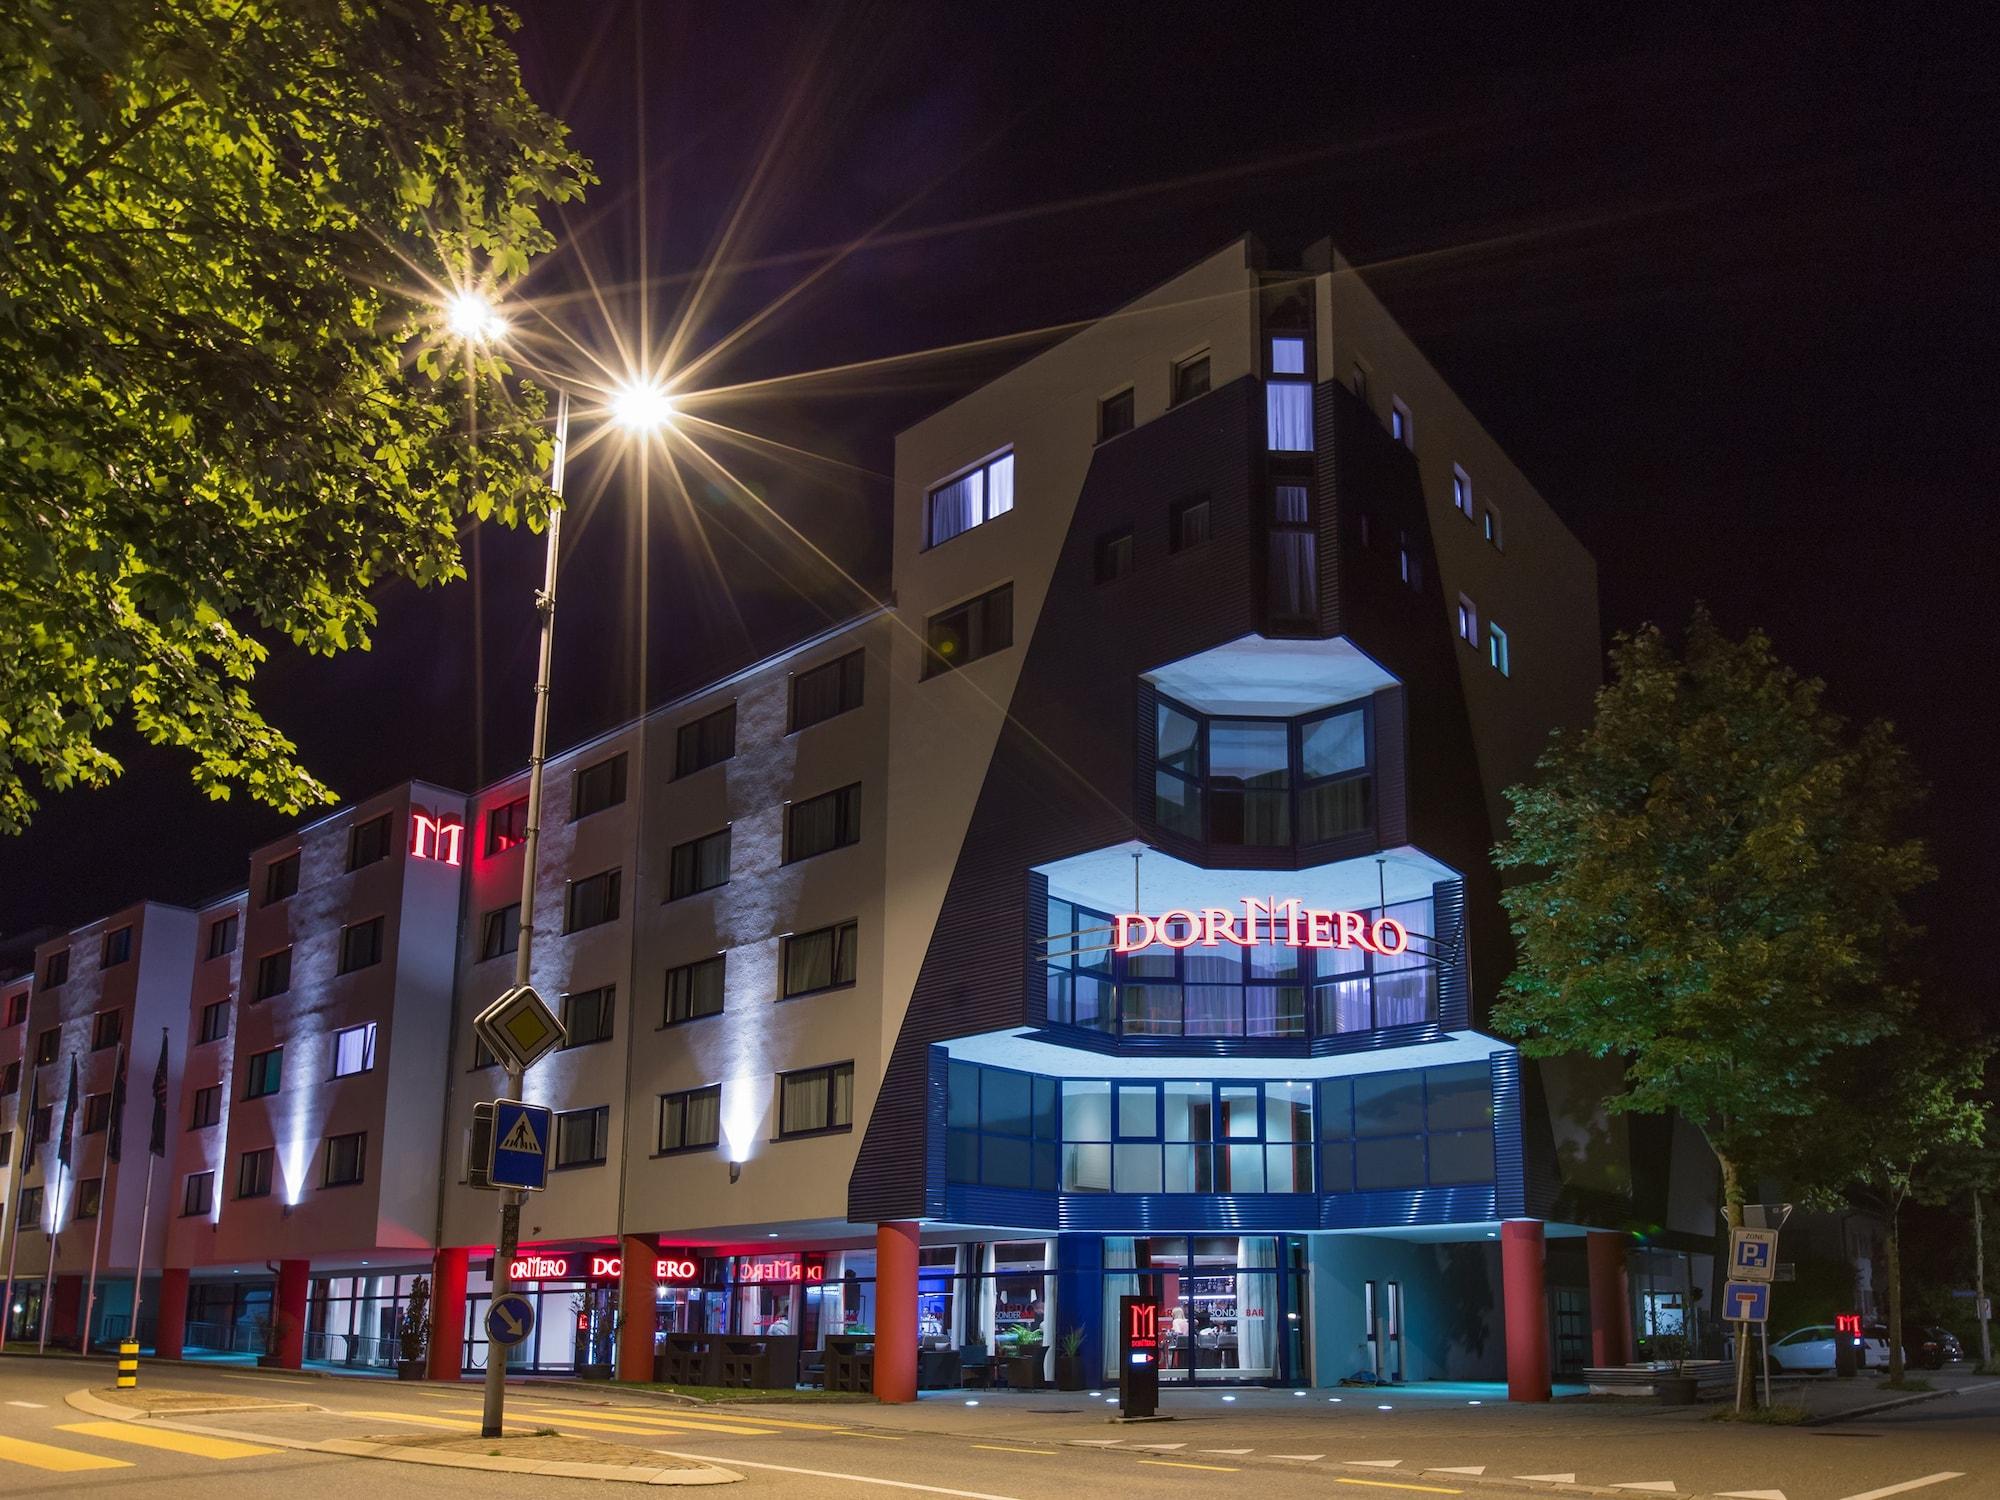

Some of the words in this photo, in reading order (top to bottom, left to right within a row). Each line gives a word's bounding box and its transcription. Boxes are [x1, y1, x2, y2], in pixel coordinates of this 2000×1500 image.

[411, 814, 464, 866] M
[1114, 895, 1408, 956] DORMERO
[510, 1256, 567, 1279] ORMERO
[592, 1257, 696, 1278] DOERO
[1131, 1303, 1155, 1338] M
